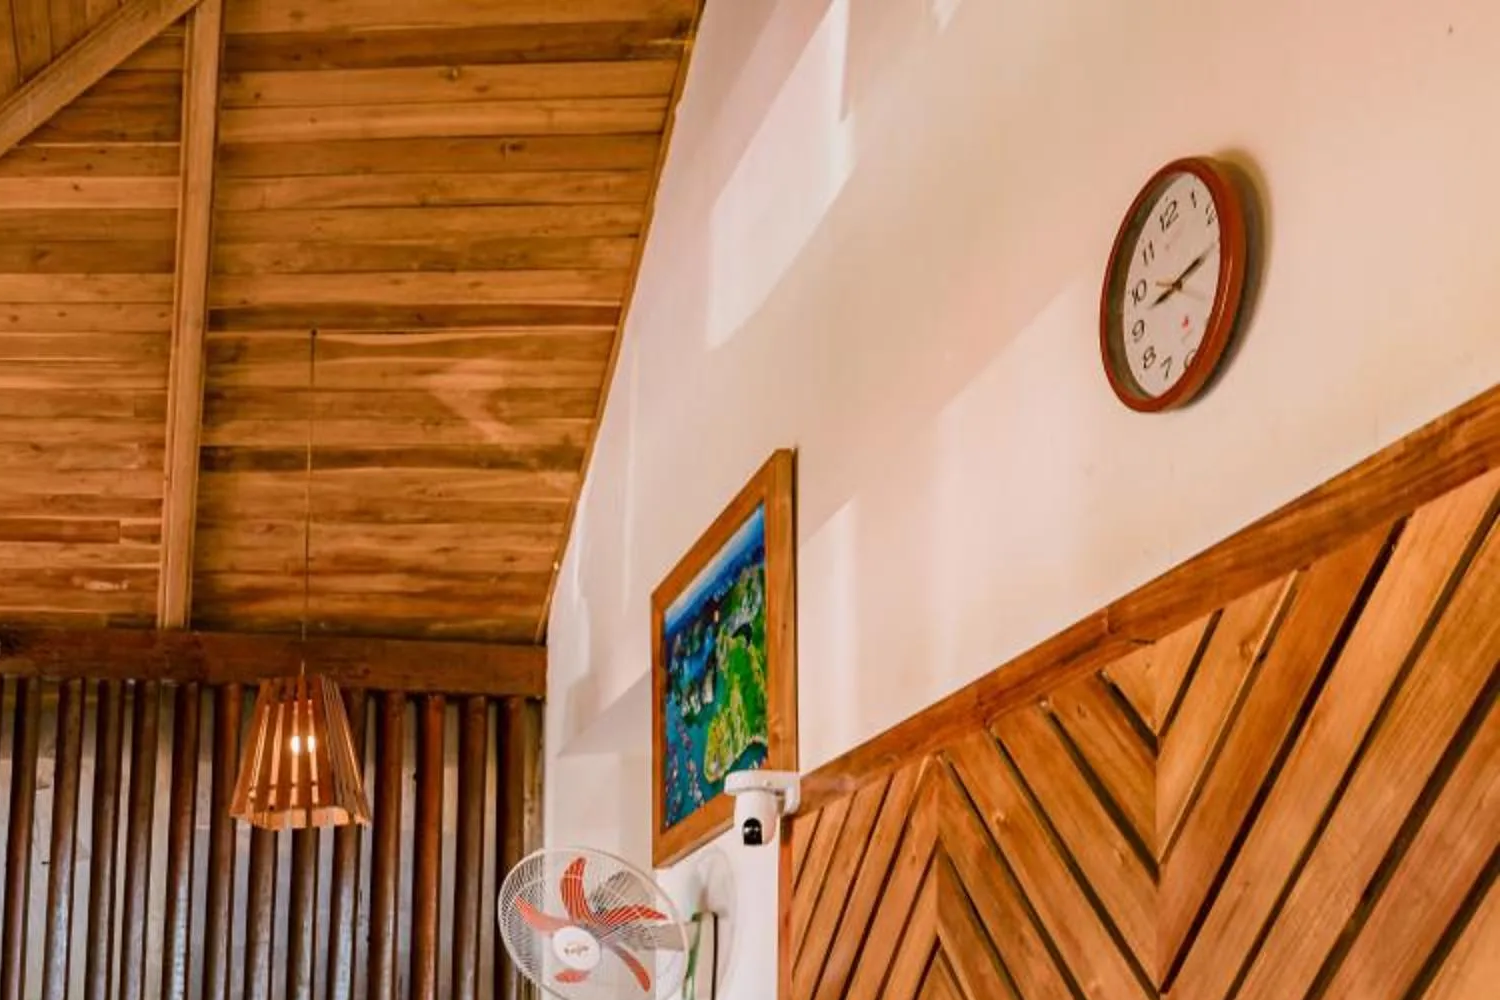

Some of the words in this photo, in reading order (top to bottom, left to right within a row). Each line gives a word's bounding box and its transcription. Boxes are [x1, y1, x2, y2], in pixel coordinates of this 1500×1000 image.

[1159, 199, 1180, 233] 12
[1142, 239, 1156, 267] 11
[1130, 278, 1148, 306] 10
[1131, 319, 1146, 343] 9
[1142, 345, 1157, 370] 8
[1160, 355, 1174, 381] 7
